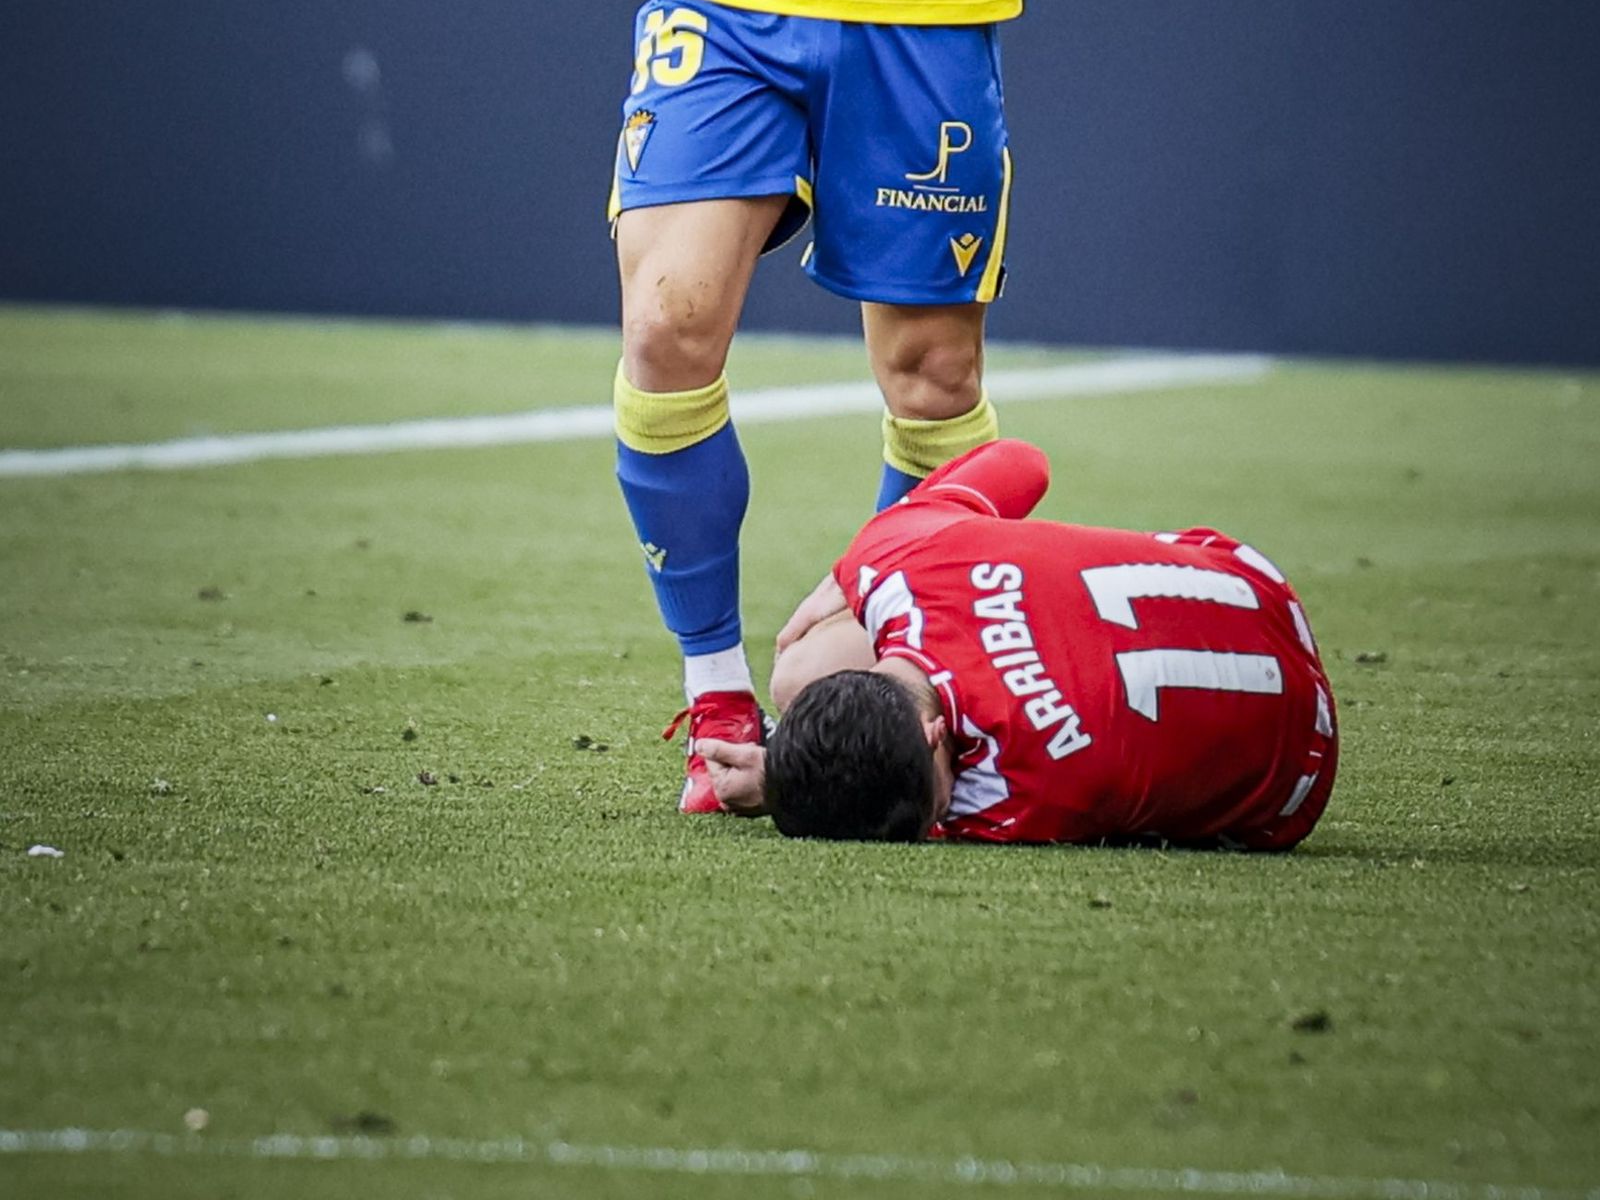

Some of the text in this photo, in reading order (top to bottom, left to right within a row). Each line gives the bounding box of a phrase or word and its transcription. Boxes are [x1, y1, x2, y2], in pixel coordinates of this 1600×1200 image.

[875, 188, 988, 213] FINANCIAL
[969, 561, 1093, 761] ARRIBAS
[1079, 562, 1285, 723] 11
